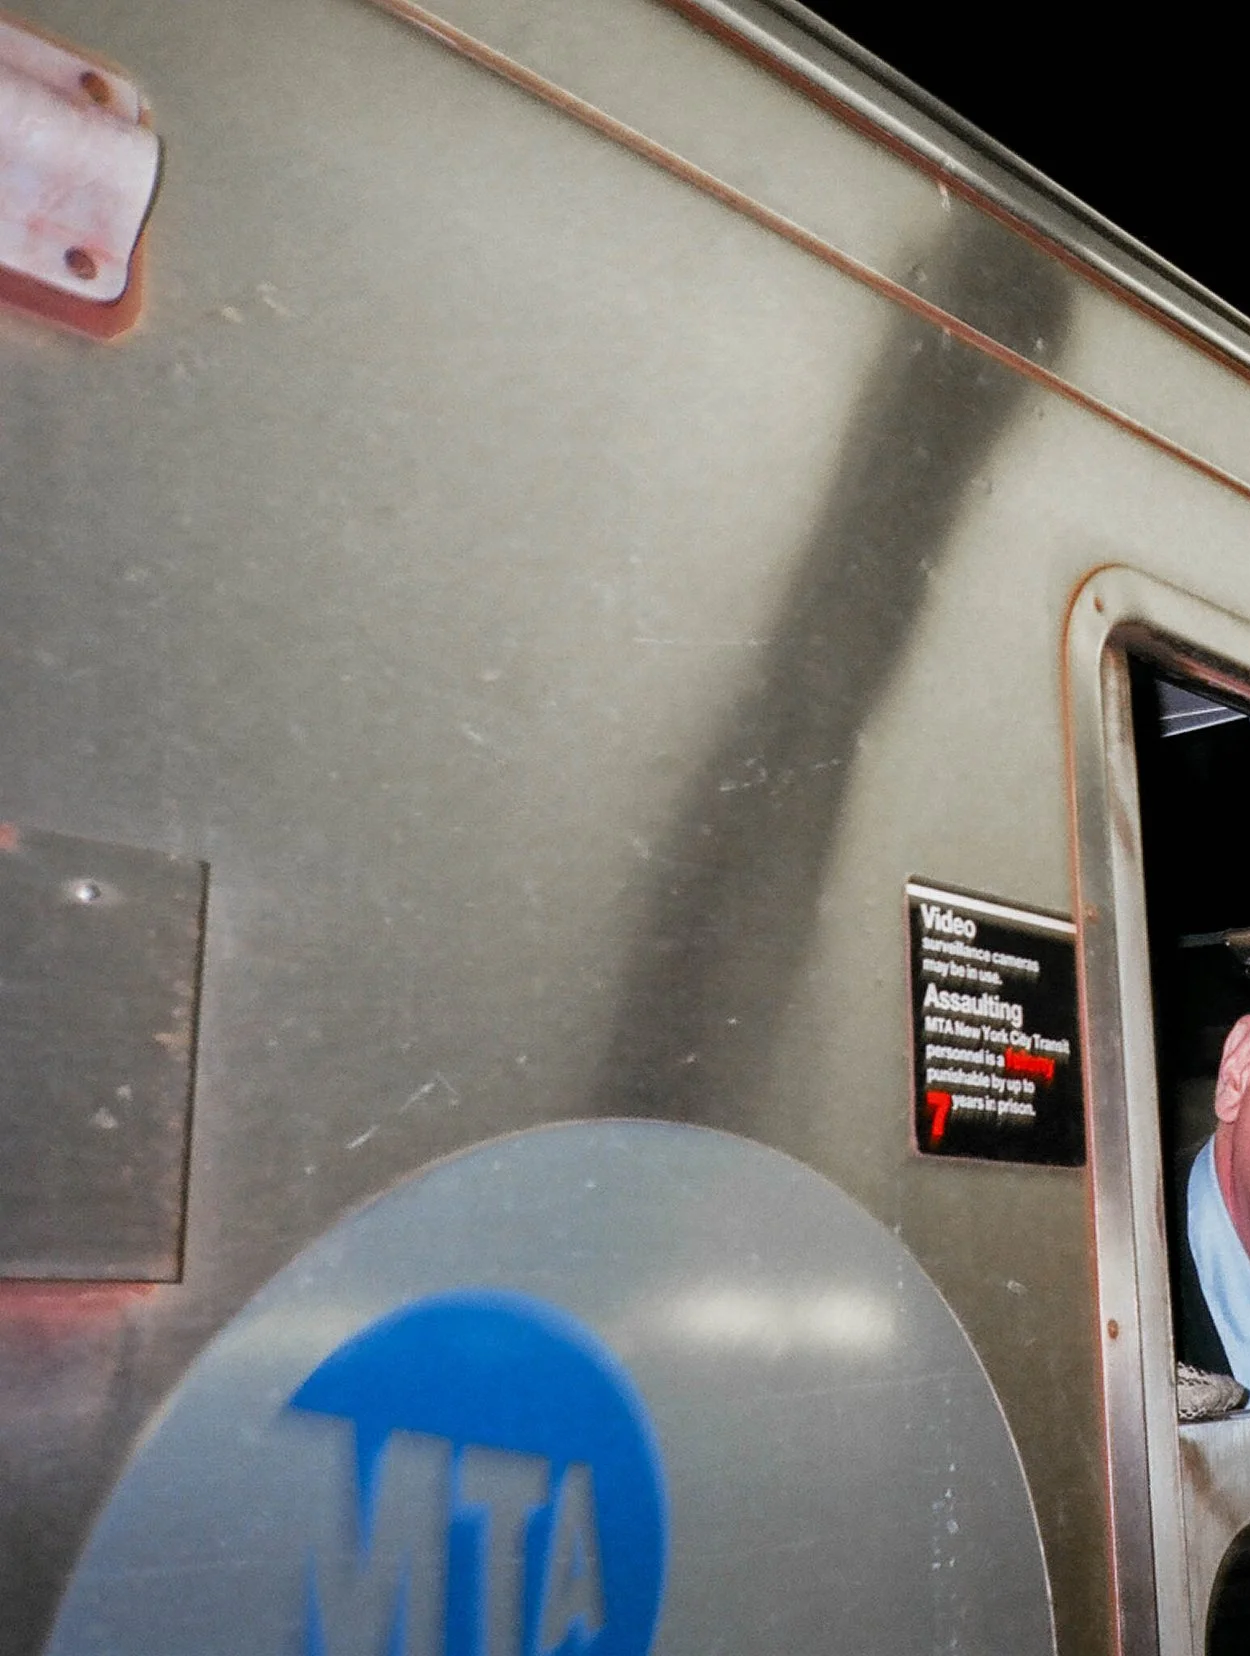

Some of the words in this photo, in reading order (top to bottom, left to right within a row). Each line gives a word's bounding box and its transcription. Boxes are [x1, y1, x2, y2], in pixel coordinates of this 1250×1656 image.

[920, 903, 977, 939] Video
[922, 937, 991, 962] surveillance
[991, 951, 1040, 973] cameras
[922, 958, 949, 977] may
[949, 961, 965, 978] be
[966, 963, 977, 980] in
[978, 966, 1003, 985] use.
[924, 982, 1023, 1028] Assaulting
[924, 1016, 954, 1034] MTA
[954, 1021, 981, 1040] New
[982, 1025, 1009, 1045] York
[1009, 1030, 1033, 1050] City
[1033, 1033, 1070, 1054] Transit
[926, 1044, 984, 1063] personnel
[985, 1049, 996, 1066] is
[997, 1055, 1005, 1068] a
[926, 1066, 991, 1088] punishable
[991, 1073, 1006, 1092] by
[1006, 1080, 1022, 1095] up
[1023, 1078, 1035, 1093] to
[926, 1091, 952, 1137] 7
[951, 1094, 984, 1110] years
[985, 1095, 997, 1111] in
[276, 1405, 605, 1656] MTA
